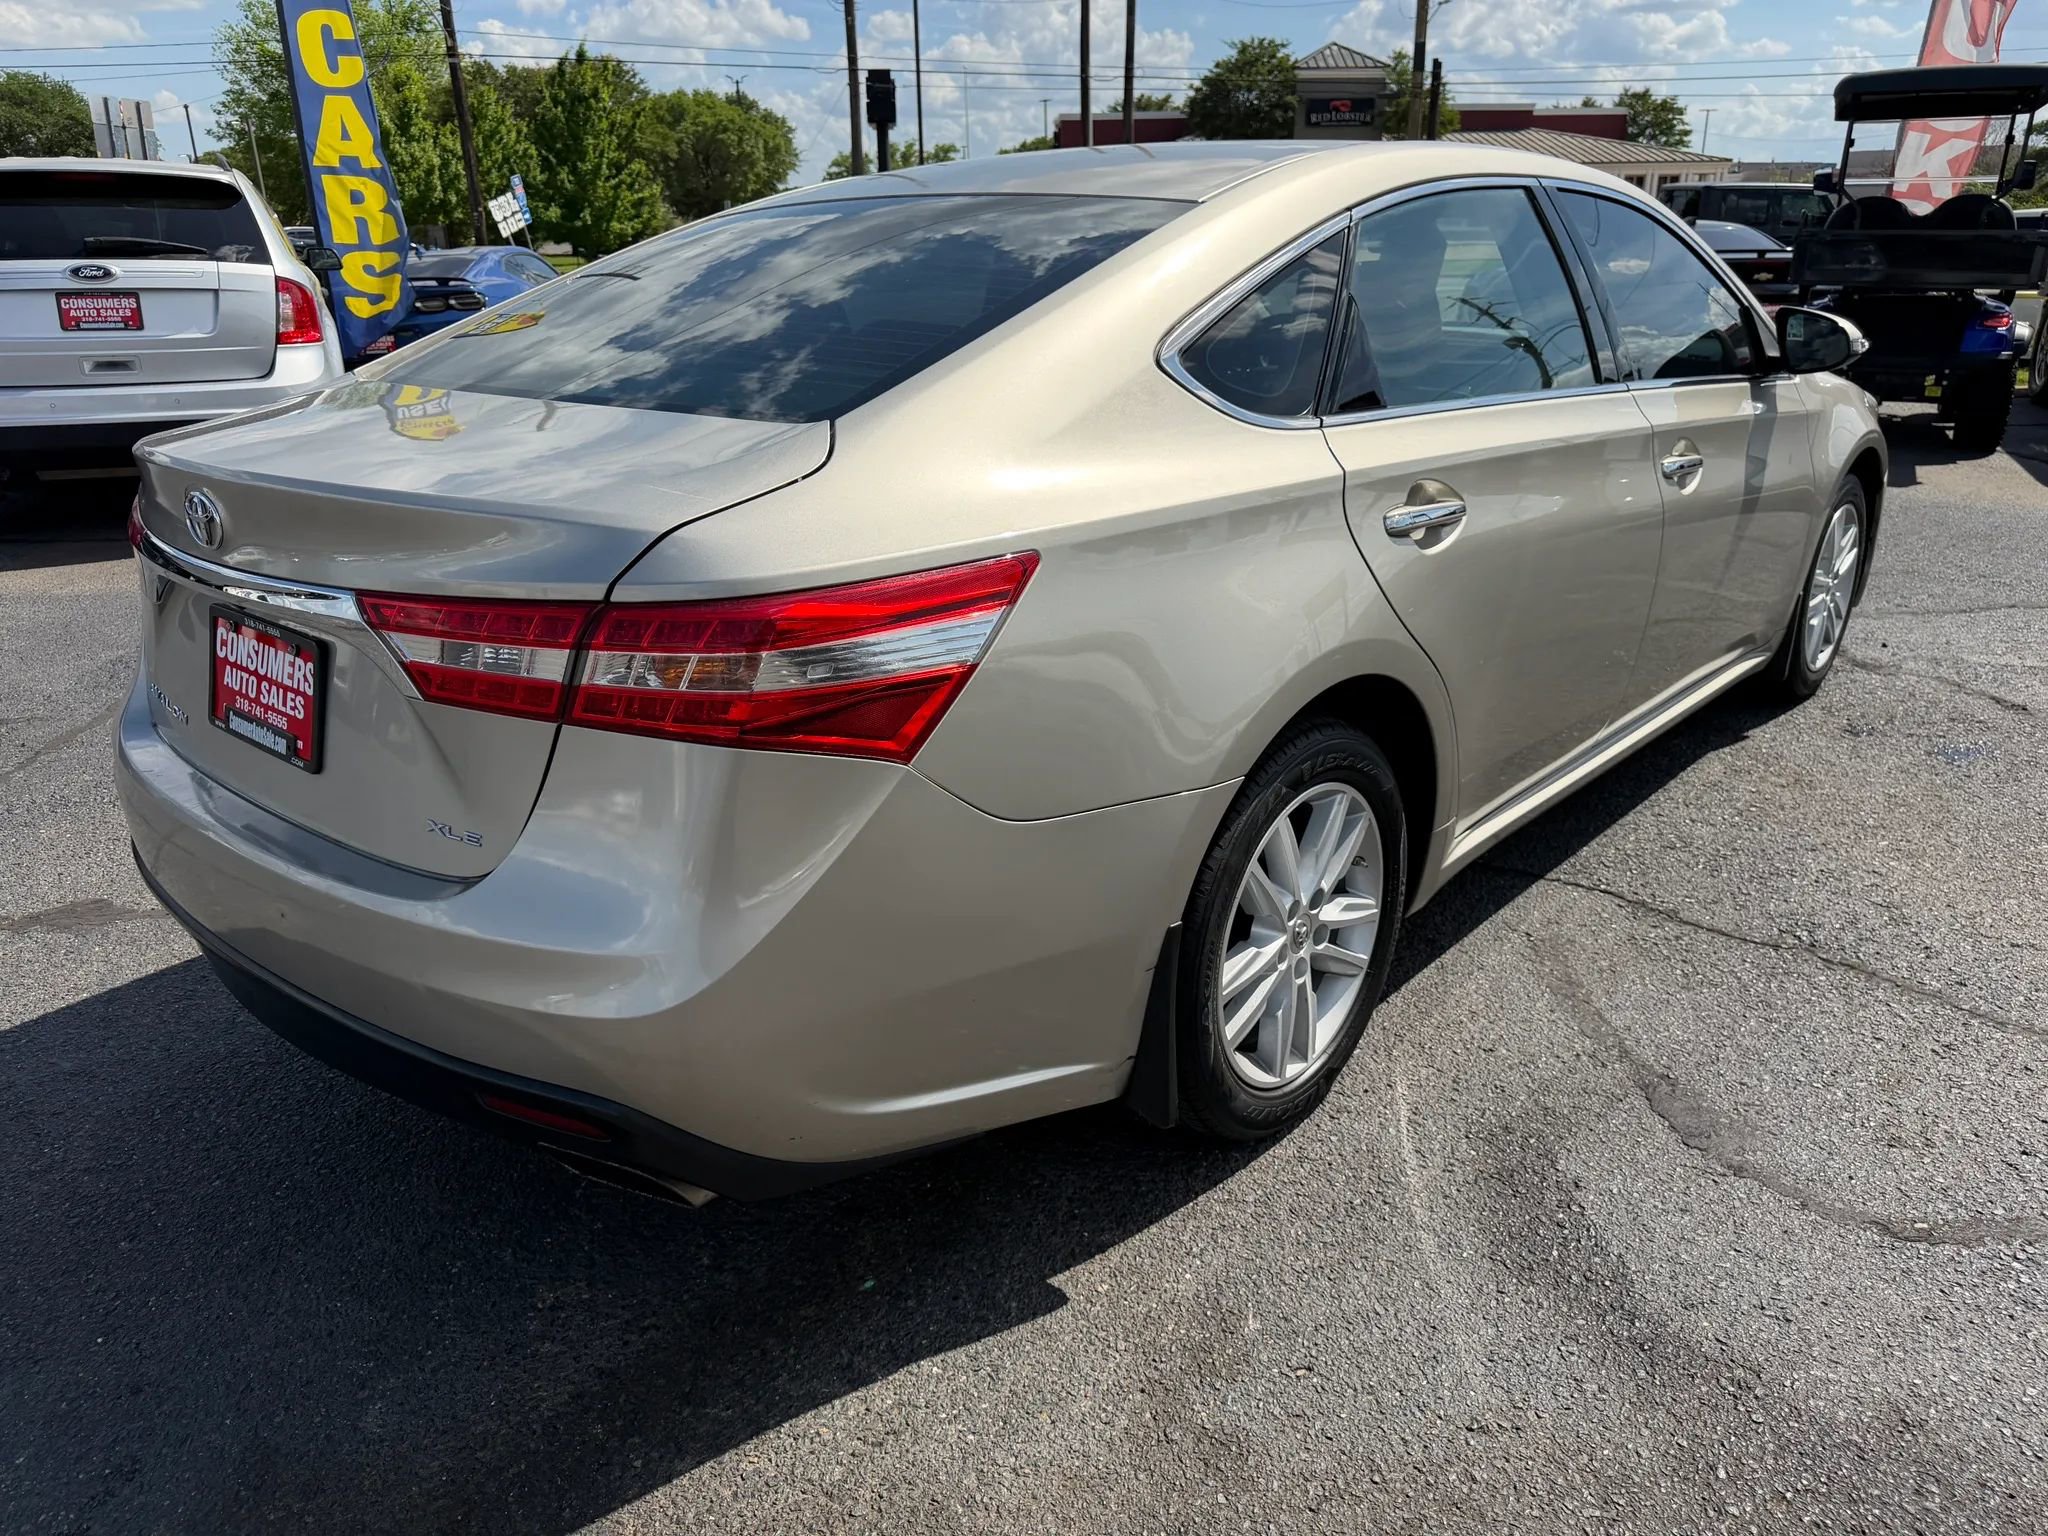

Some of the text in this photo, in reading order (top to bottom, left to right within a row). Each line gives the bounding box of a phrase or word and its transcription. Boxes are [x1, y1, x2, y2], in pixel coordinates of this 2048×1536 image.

[1331, 111, 1371, 121] LOBSTER
[296, 9, 402, 319] CARS
[78, 266, 105, 277] Ford
[60, 298, 137, 309] CONSUMERS
[69, 308, 132, 317] AUTO SALES
[216, 626, 314, 696] CONSUMERS
[223, 664, 305, 720] AUTO SALES
[235, 695, 288, 731] 318-741-5555
[426, 817, 483, 848] XLE
